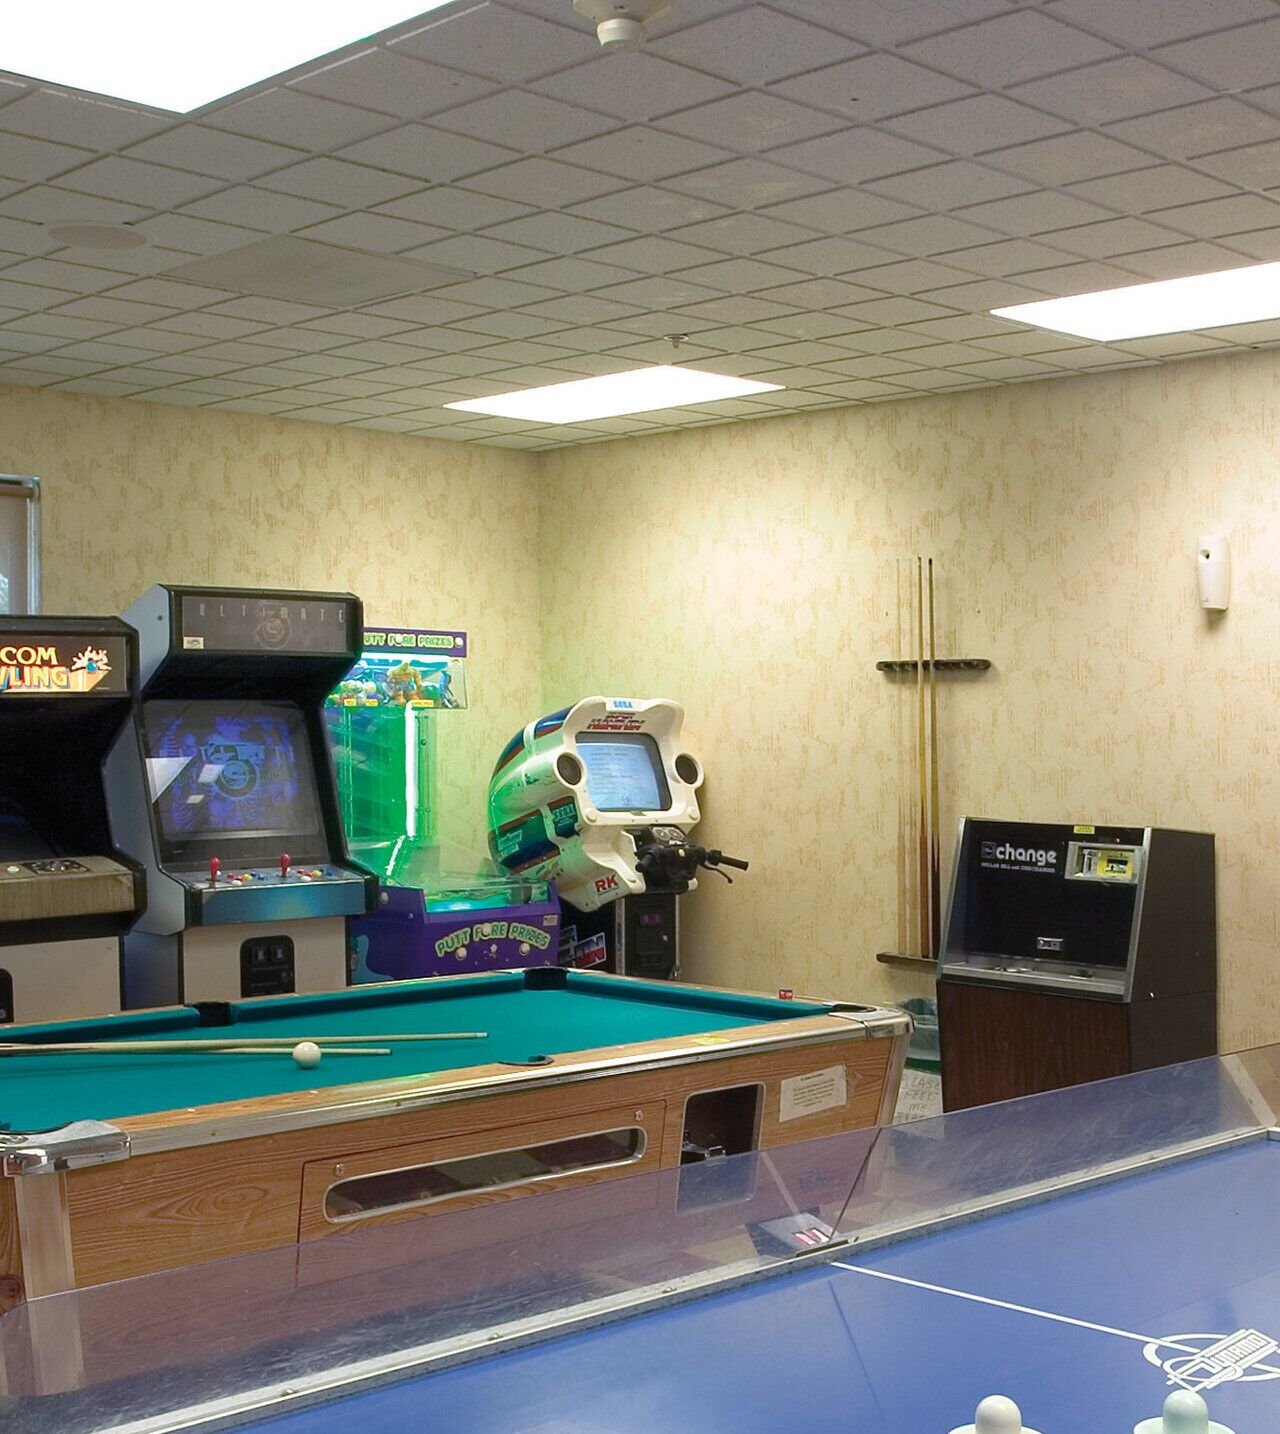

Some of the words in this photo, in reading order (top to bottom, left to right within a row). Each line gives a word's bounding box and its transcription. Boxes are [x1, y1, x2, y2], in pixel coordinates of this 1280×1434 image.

[199, 603, 345, 623] ULTIMATE
[363, 632, 386, 645] UTT
[418, 634, 454, 649] PRIZES
[995, 843, 1057, 866] change
[594, 874, 619, 892] RK
[435, 928, 471, 957] PUTT
[473, 922, 508, 942] FORE
[509, 922, 551, 950] PRIZES
